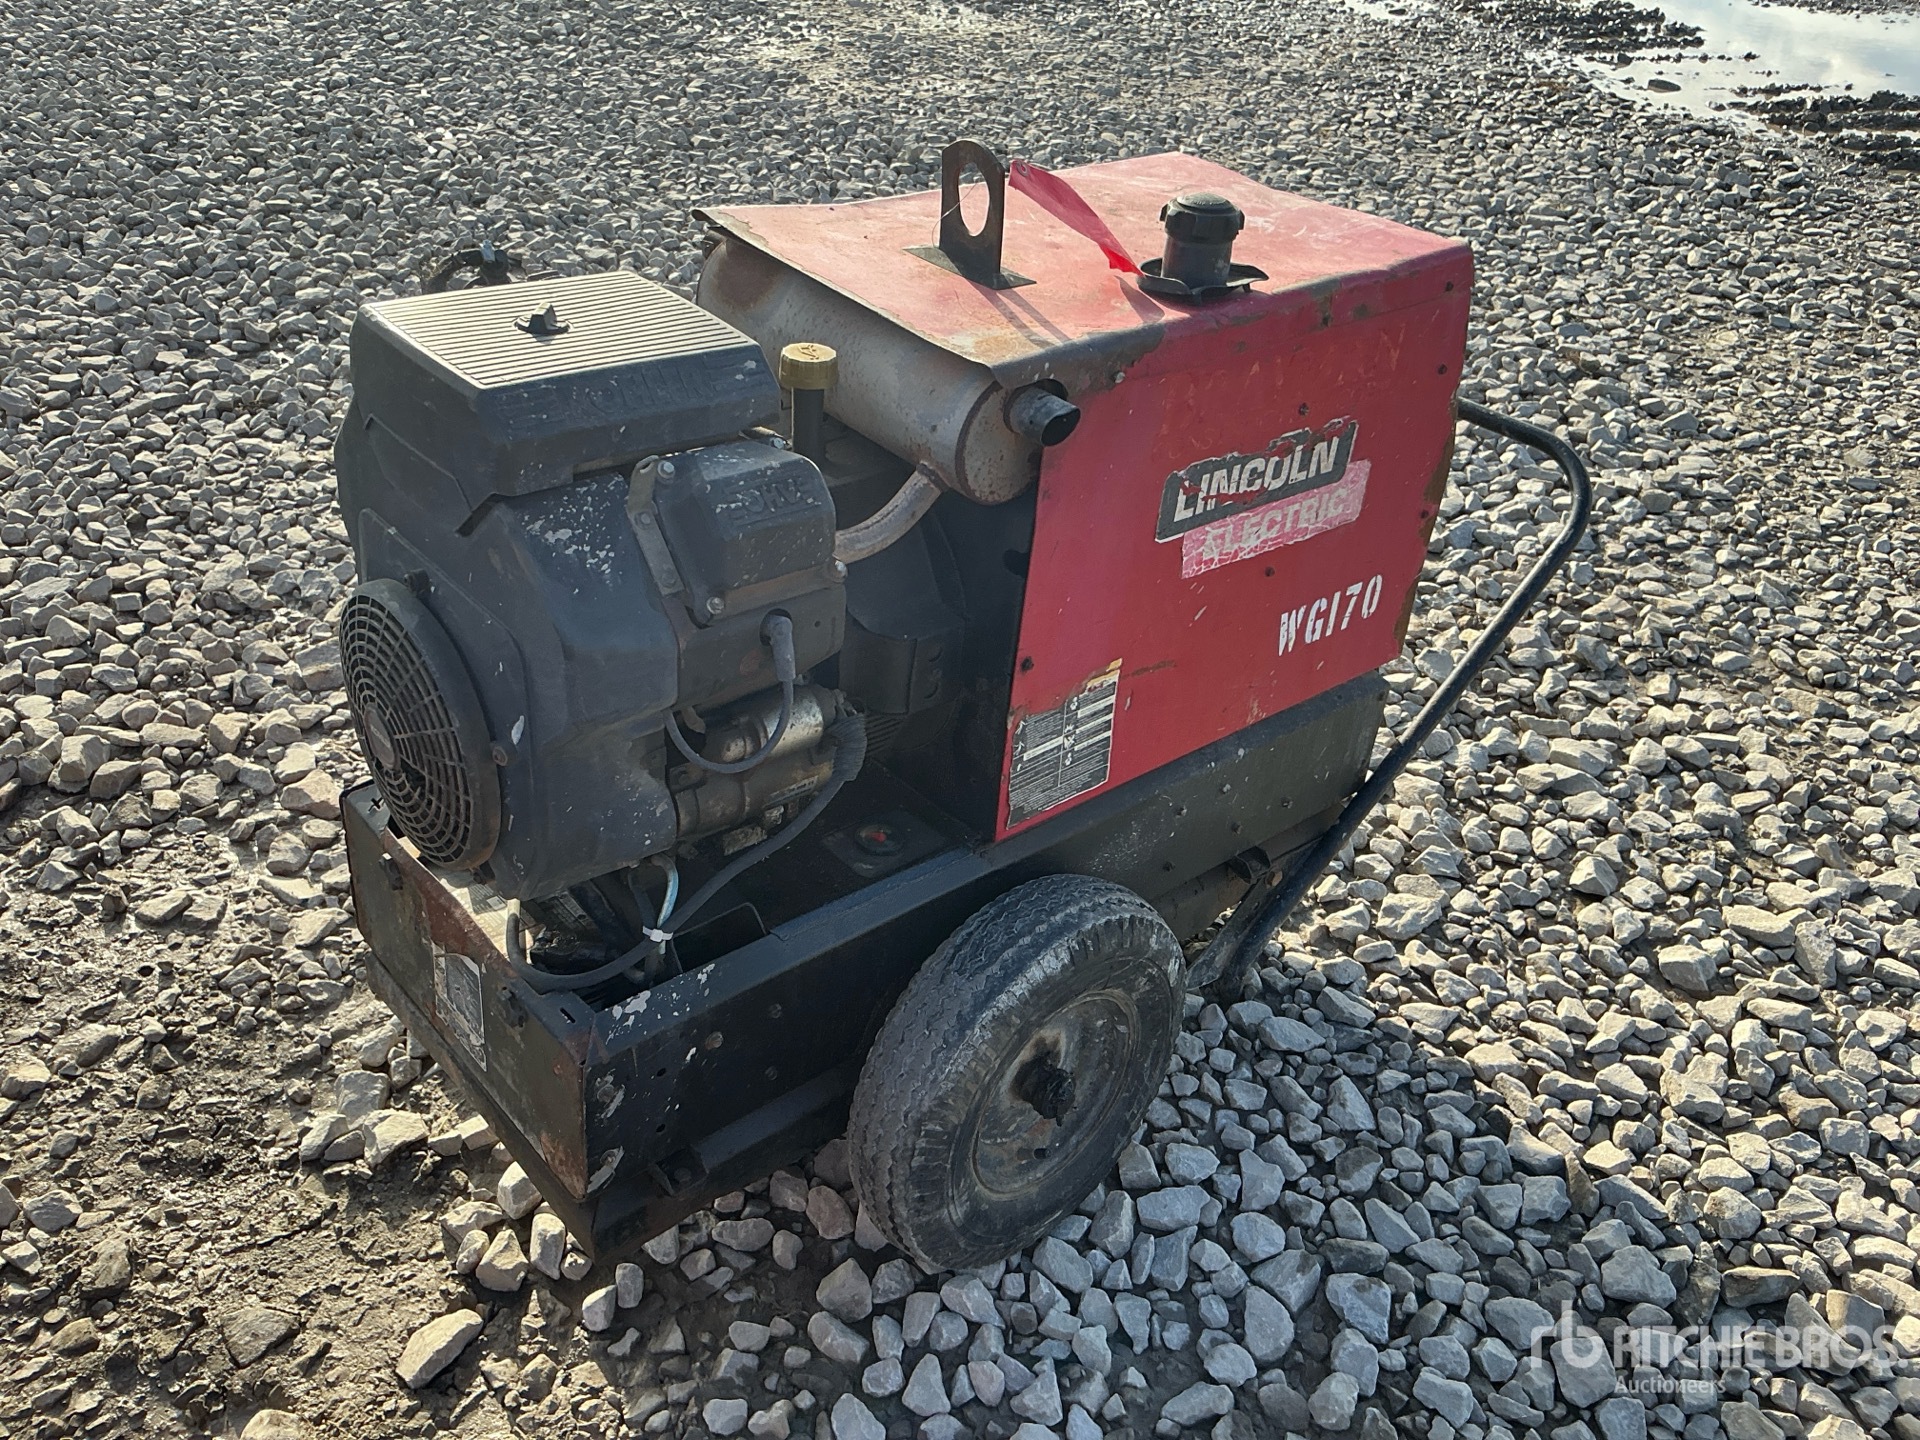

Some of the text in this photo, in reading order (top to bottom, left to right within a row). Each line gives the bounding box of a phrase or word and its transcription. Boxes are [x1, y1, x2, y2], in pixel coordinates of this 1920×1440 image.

[1173, 436, 1339, 522] LINCOLN
[1202, 487, 1350, 559] ELECTRIC
[1278, 574, 1382, 656] WG170
